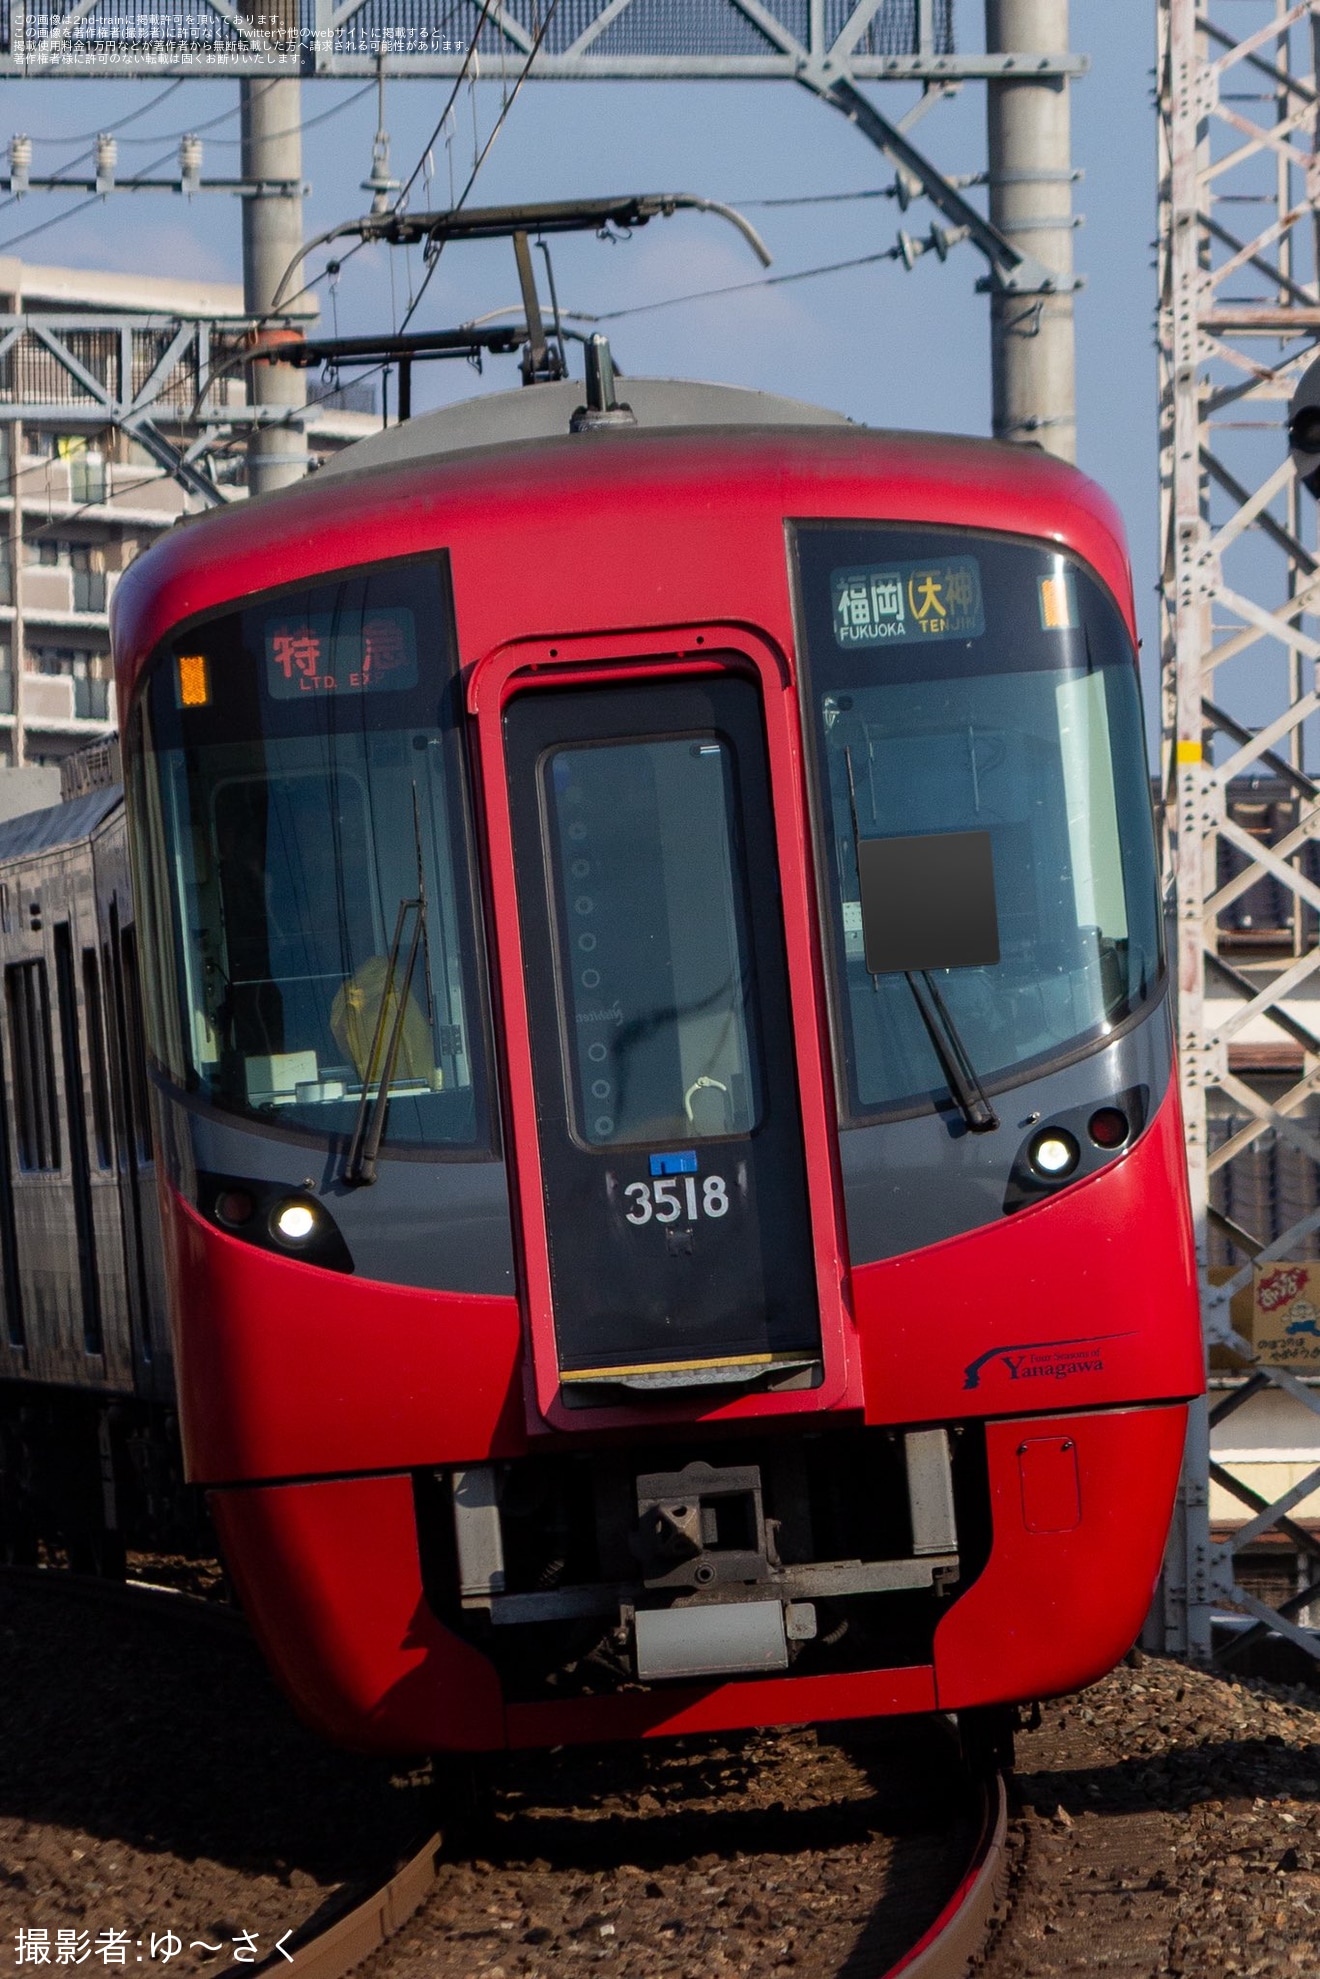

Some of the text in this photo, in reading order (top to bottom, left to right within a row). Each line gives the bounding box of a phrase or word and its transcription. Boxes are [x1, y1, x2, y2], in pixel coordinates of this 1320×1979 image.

[839, 622, 906, 641] FUKUOKA
[300, 674, 338, 690] LTD.
[624, 1175, 729, 1225] 3518
[1030, 1347, 1102, 1363] Four Seasons of
[1001, 1355, 1104, 1380] Yanagawa
